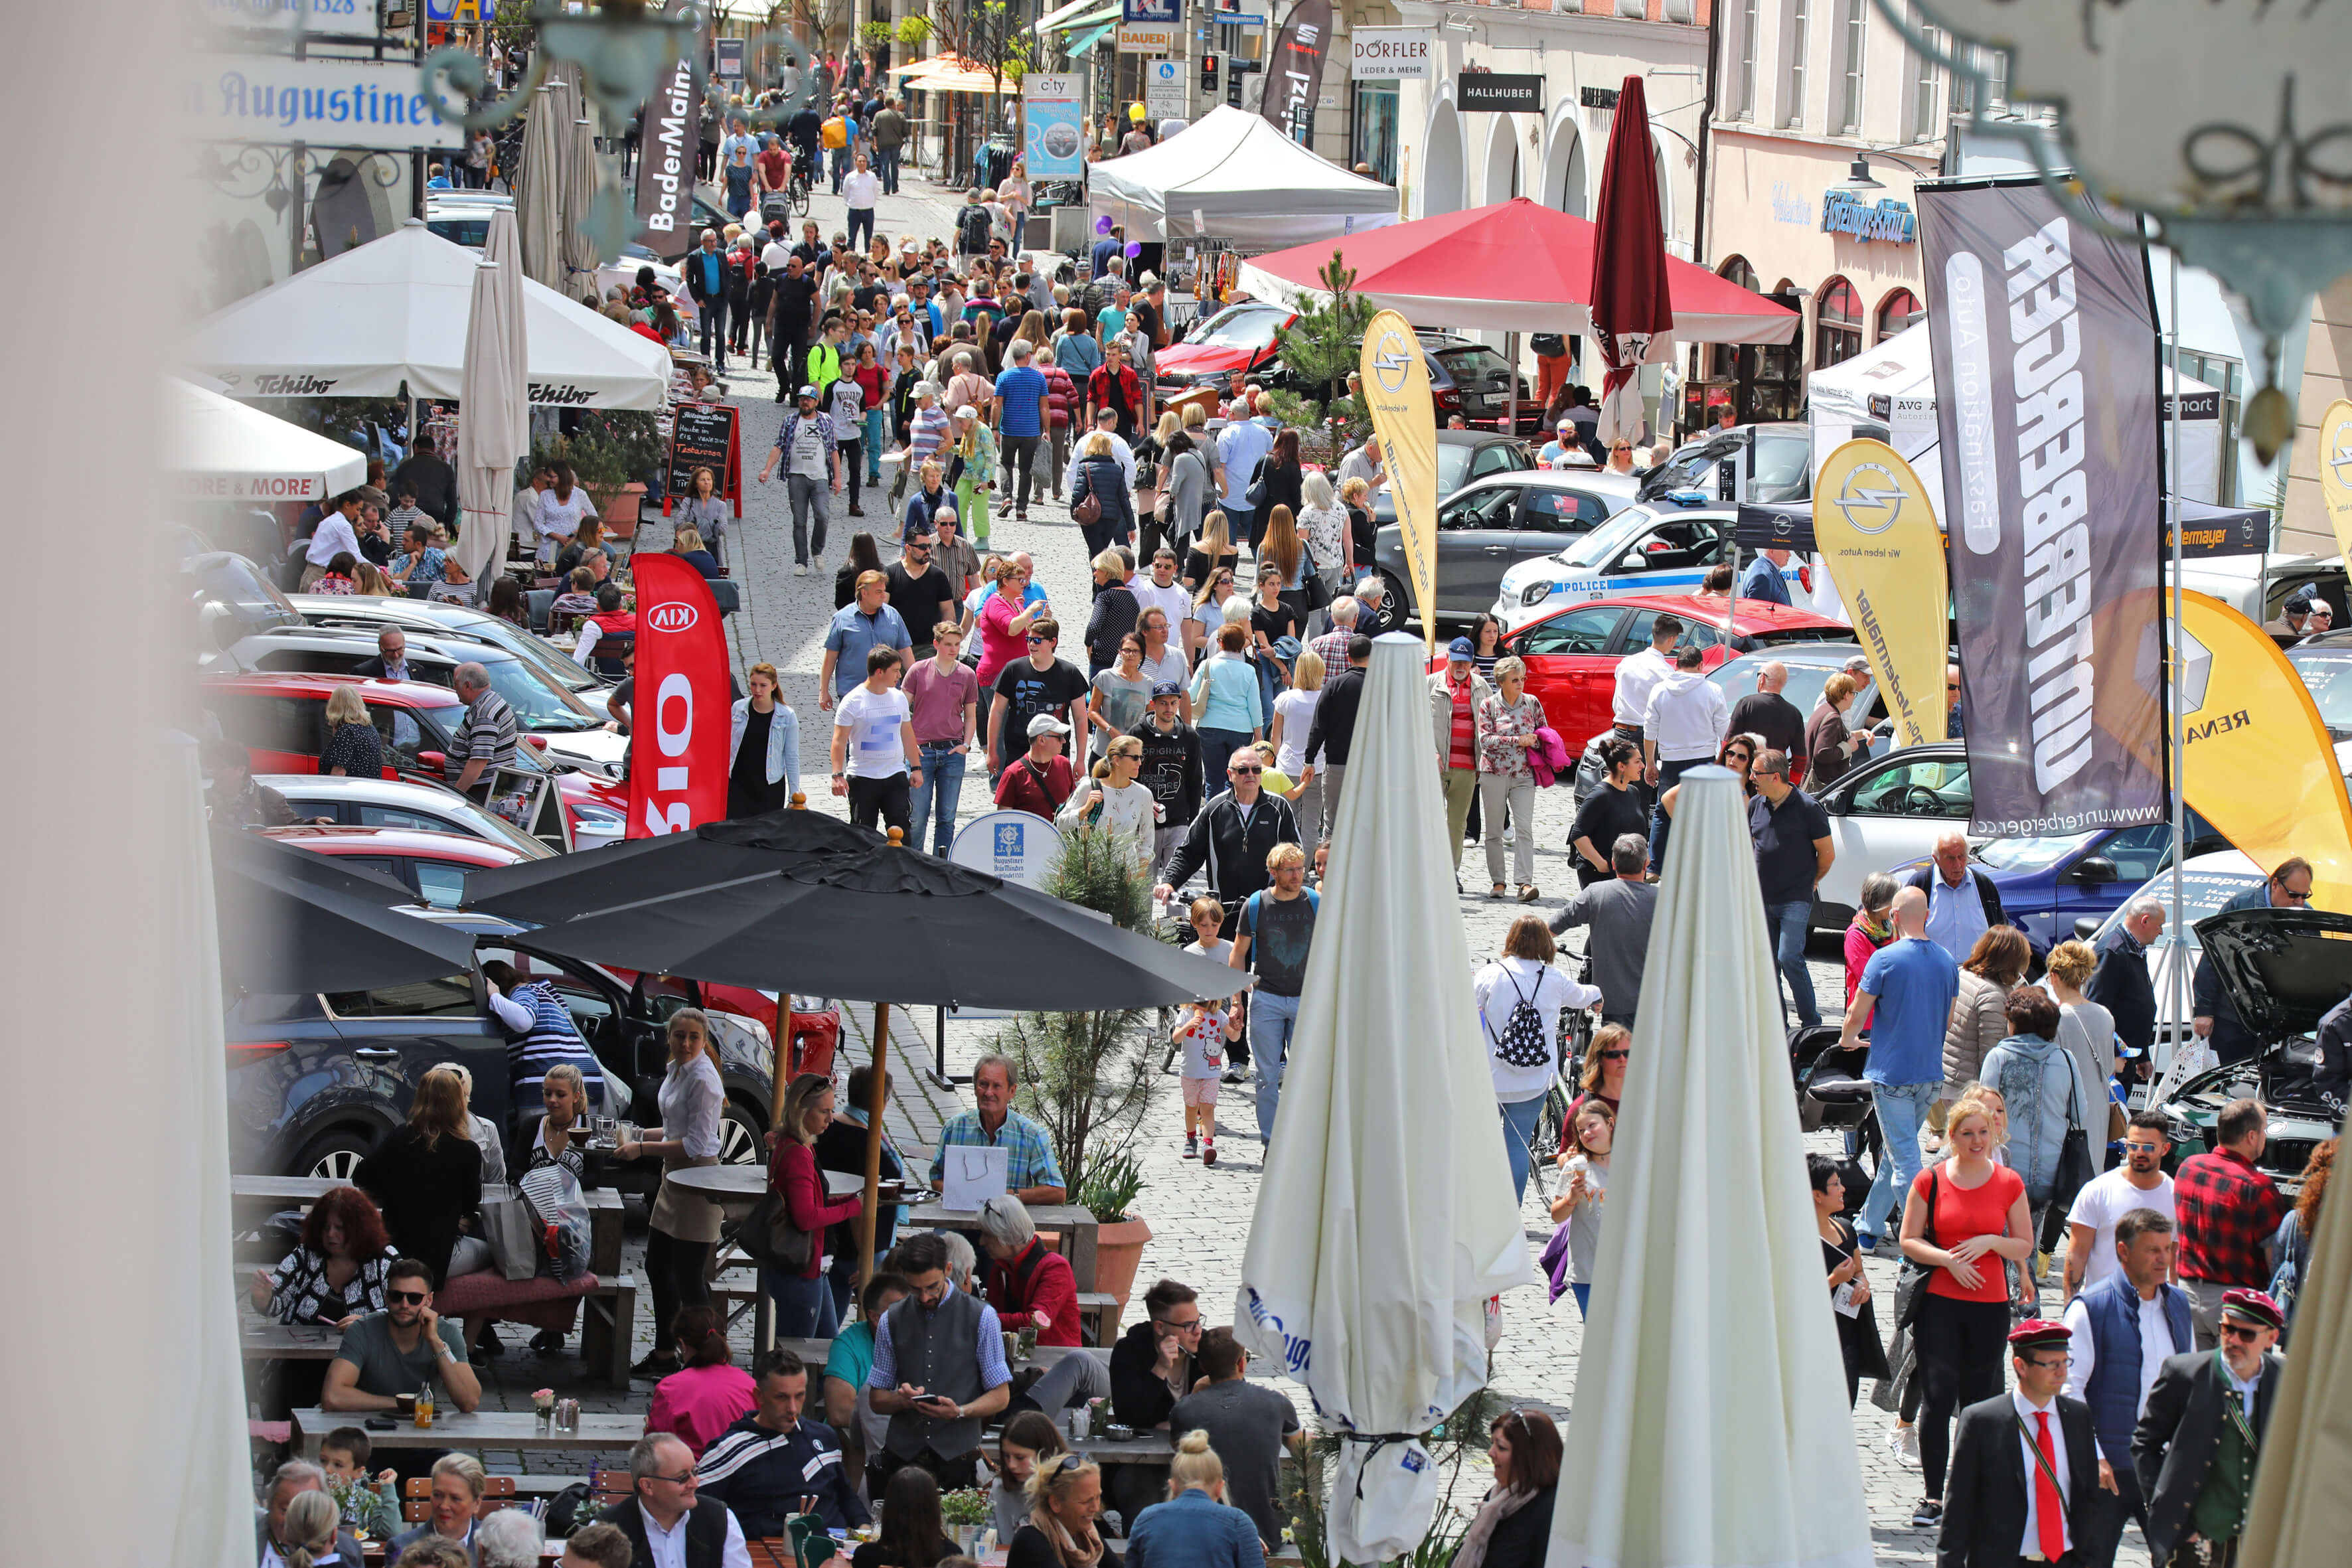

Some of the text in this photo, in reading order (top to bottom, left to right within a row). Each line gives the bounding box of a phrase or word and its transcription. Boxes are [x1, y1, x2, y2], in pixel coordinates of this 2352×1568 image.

[1216, 15, 1261, 23] Prinzregentenstr.
[1121, 33, 1166, 44] BAUER
[1287, 42, 1320, 57] SEAT
[1355, 39, 1427, 58] DÖRFLER
[1041, 78, 1066, 94] city
[1467, 88, 1532, 98] HALLHUBER
[254, 374, 338, 394] Tchibo
[1875, 400, 1890, 416] smart
[1897, 401, 1922, 410] AVG
[234, 483, 244, 495] &
[250, 478, 312, 495] MORE
[1564, 580, 1607, 592] POLICE
[1141, 774, 1165, 783] DENIM
[1265, 913, 1308, 922] FIESTA
